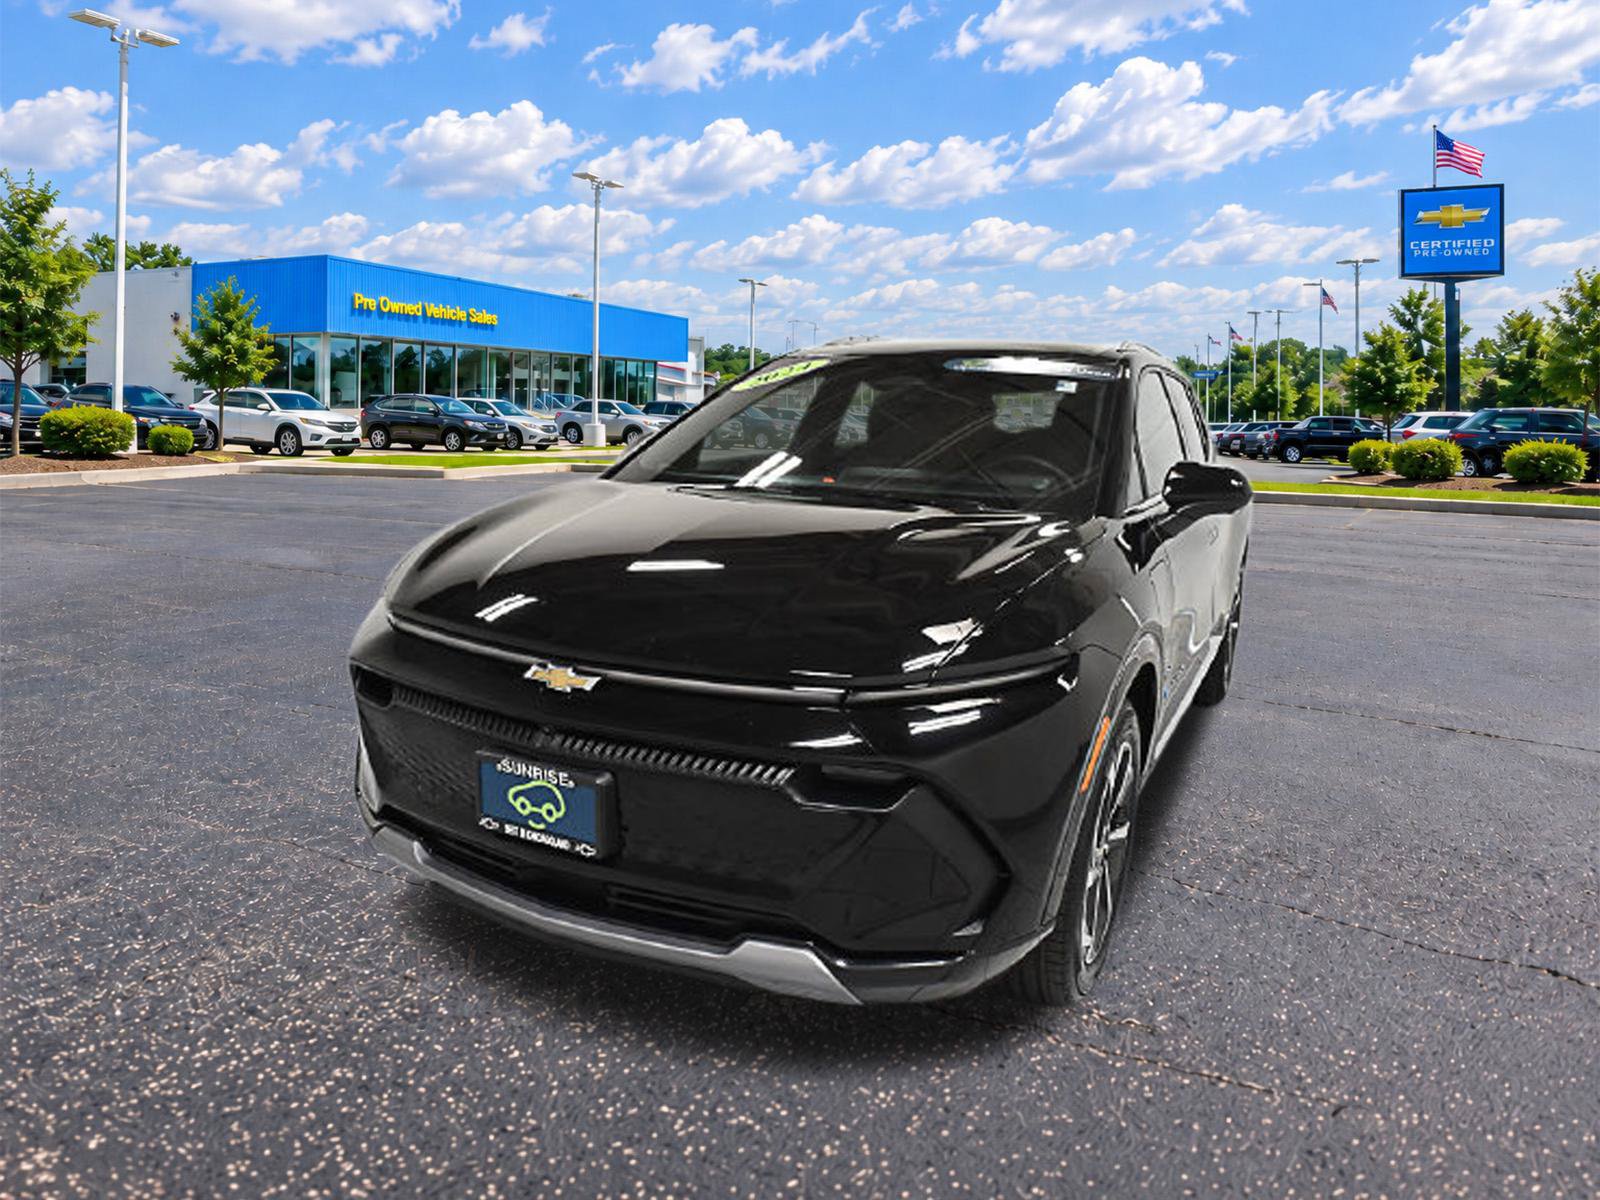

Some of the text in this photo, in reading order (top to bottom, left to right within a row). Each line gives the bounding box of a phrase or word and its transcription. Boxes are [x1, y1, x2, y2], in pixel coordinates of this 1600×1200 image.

[1410, 238, 1495, 250] CERTIFIED
[1414, 248, 1490, 257] PRE-OWNED
[353, 292, 498, 325] Pre Owned Vehicle Sales
[499, 758, 569, 787] SUNRISE
